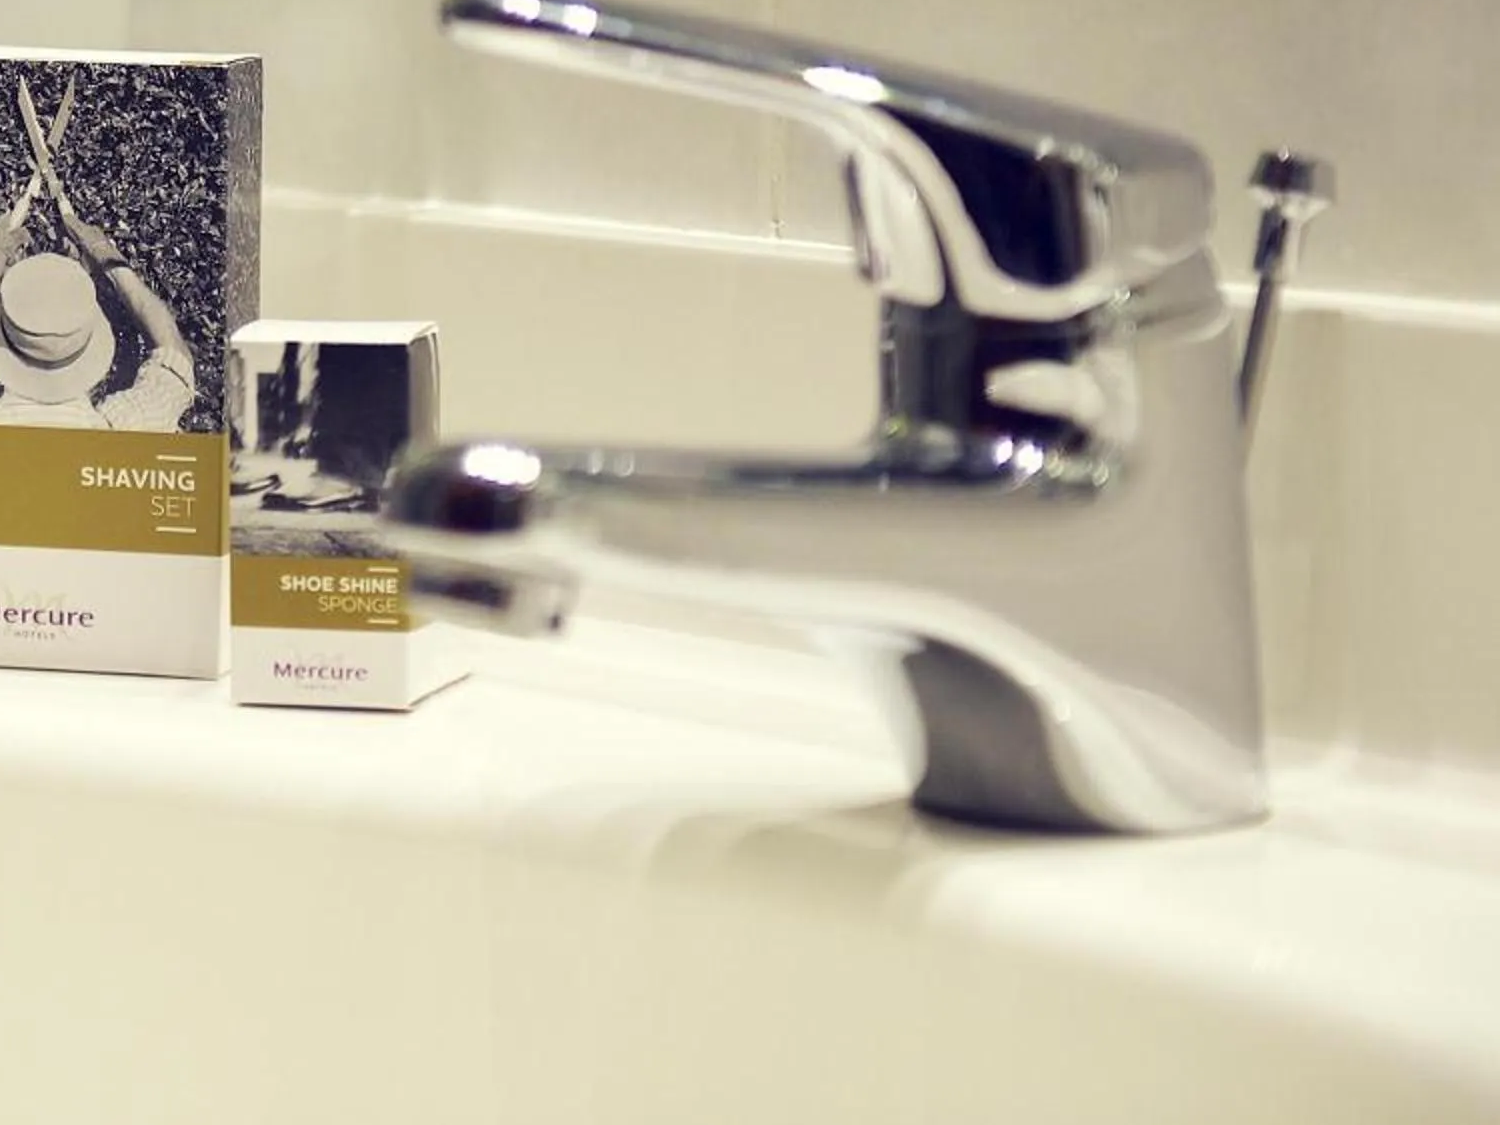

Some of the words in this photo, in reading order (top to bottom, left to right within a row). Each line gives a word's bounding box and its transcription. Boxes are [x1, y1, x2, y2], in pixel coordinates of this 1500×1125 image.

[80, 466, 196, 492] SHAVING
[150, 495, 197, 518] SET
[279, 574, 335, 593] SHOE
[338, 576, 399, 594] SHINE
[318, 595, 398, 615] SPONGE
[272, 660, 369, 682] Mercure
